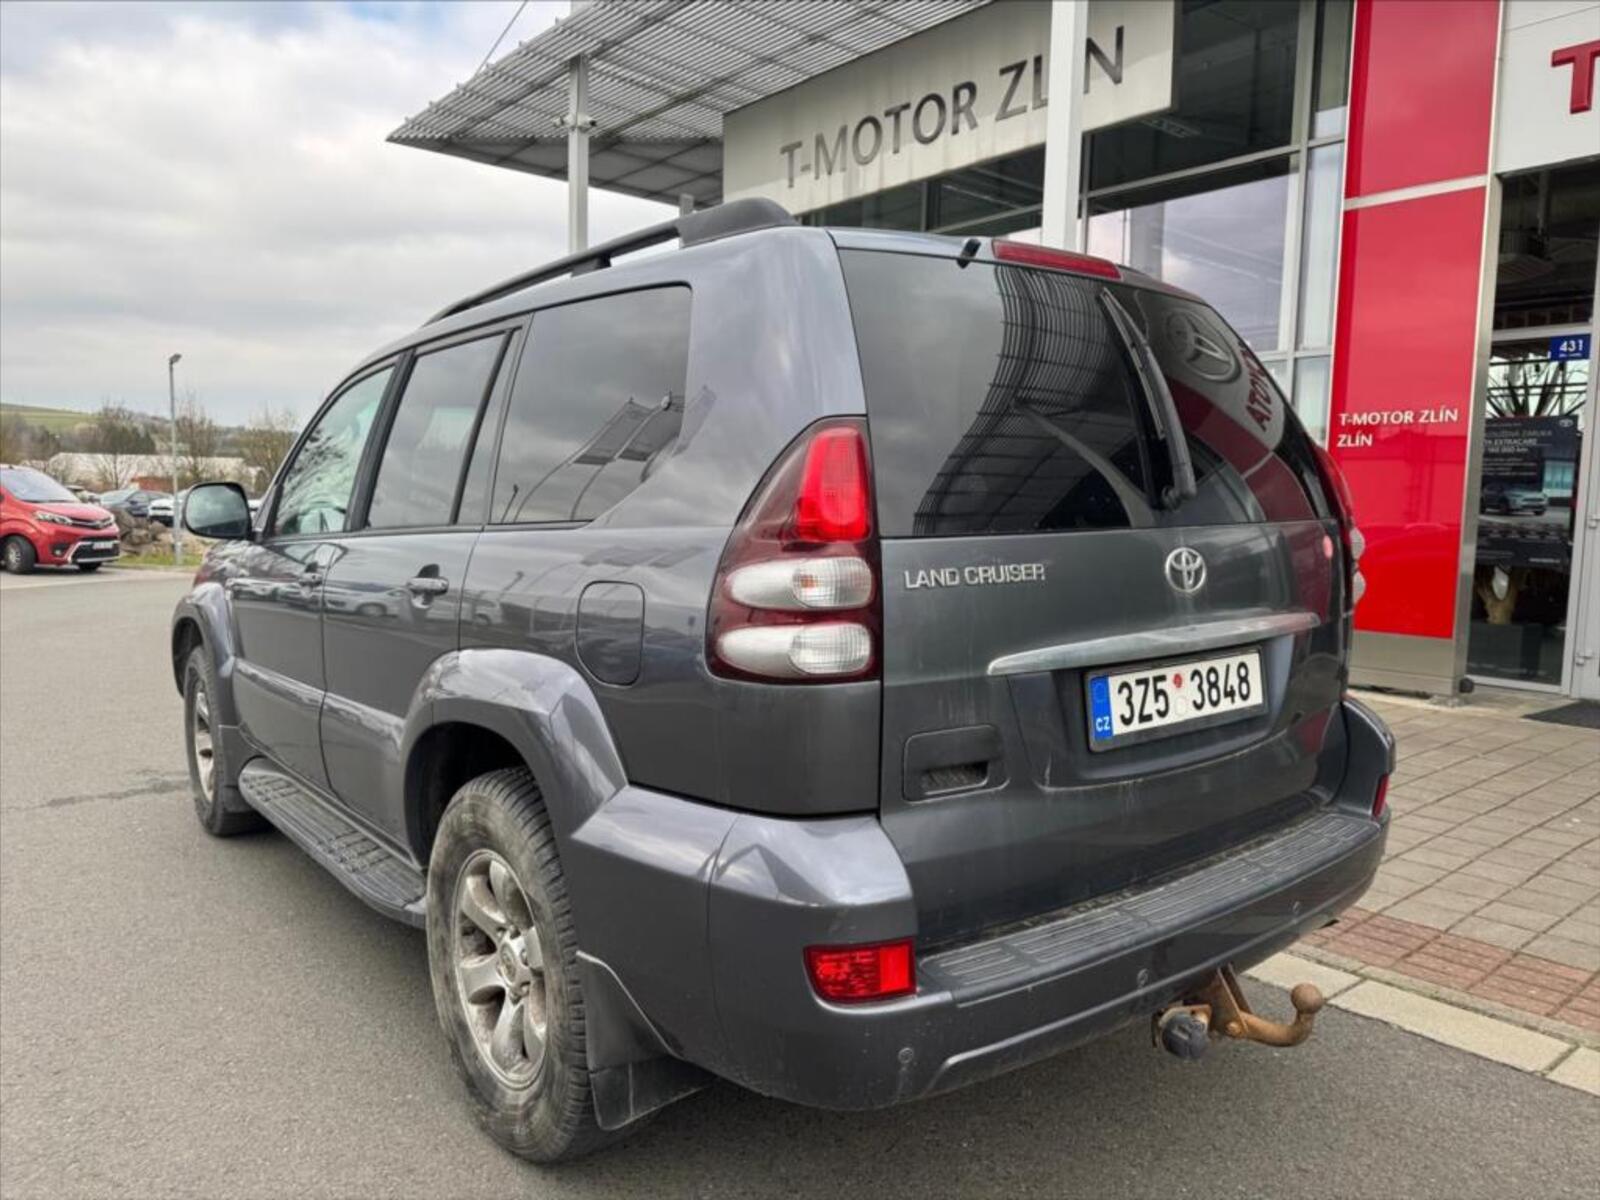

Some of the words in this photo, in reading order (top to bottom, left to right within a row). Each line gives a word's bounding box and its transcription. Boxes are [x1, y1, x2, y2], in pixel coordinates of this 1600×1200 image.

[780, 81, 978, 188] T-MOTOR
[995, 25, 1124, 121] ZLN
[1559, 339, 1583, 352] 431
[1339, 410, 1415, 426] T-MOTOR
[1419, 404, 1458, 423] ZLÍN
[1336, 429, 1373, 448] ZLÍN
[904, 568, 960, 589] LAND
[964, 563, 1046, 585] CRUISER
[1117, 674, 1170, 726] 3Z5
[1190, 661, 1250, 711] 3848
[1095, 716, 1111, 732] CZ
